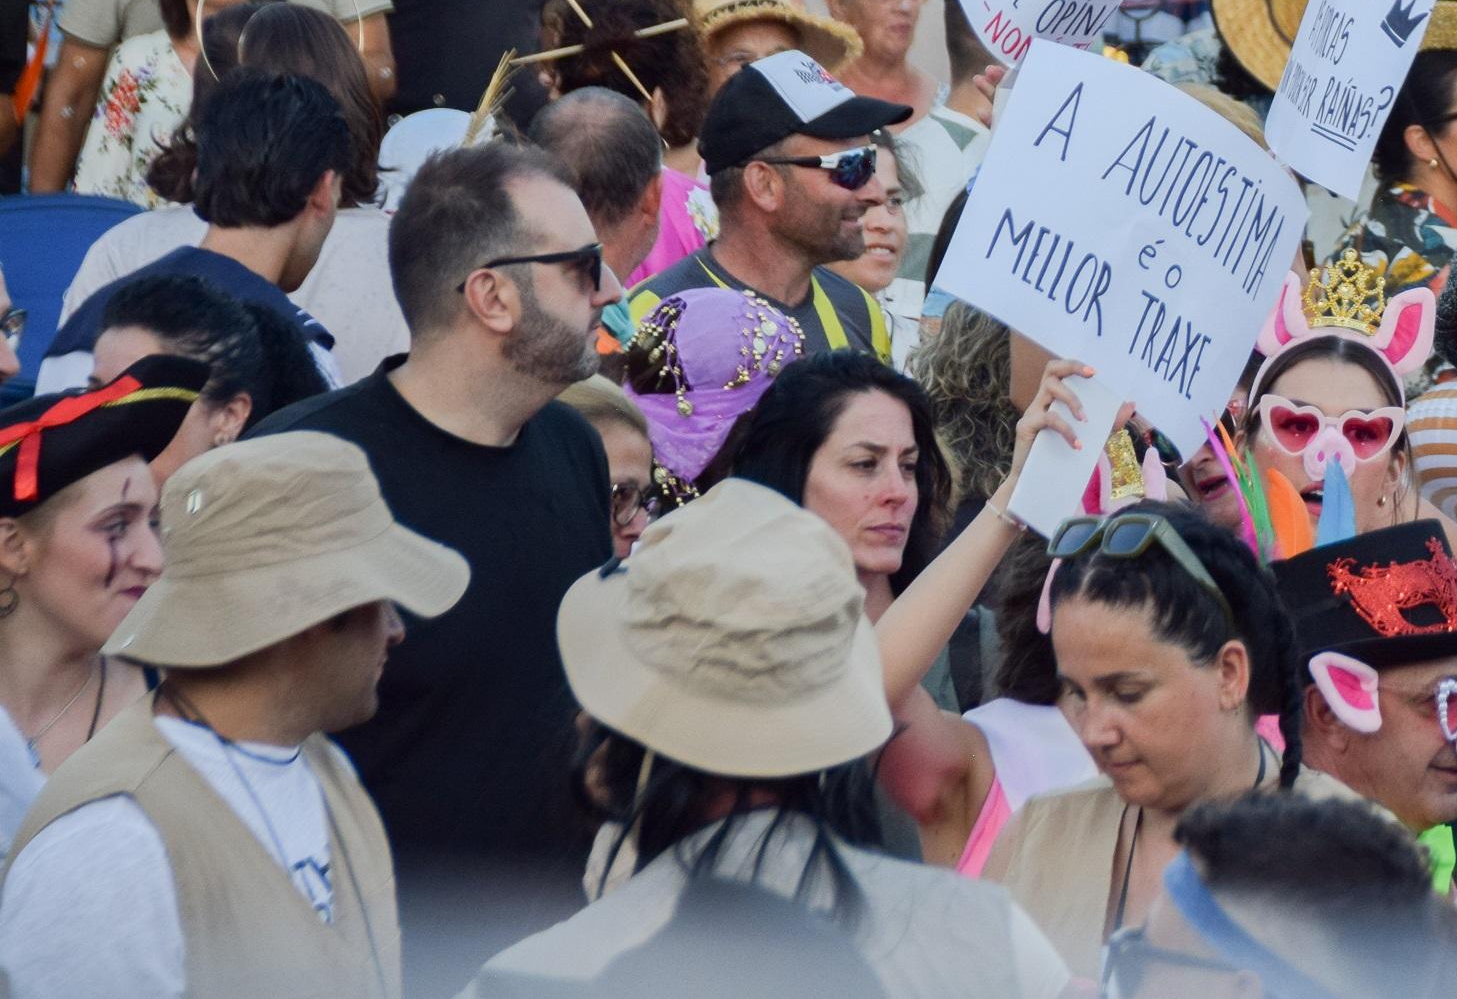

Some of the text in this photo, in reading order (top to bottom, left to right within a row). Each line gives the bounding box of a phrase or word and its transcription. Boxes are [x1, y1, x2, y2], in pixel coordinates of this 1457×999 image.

[1033, 81, 1286, 301] A AUTOESTIMA
[1138, 239, 1182, 289] é o
[985, 207, 1212, 400] MELLOR TRAXE
